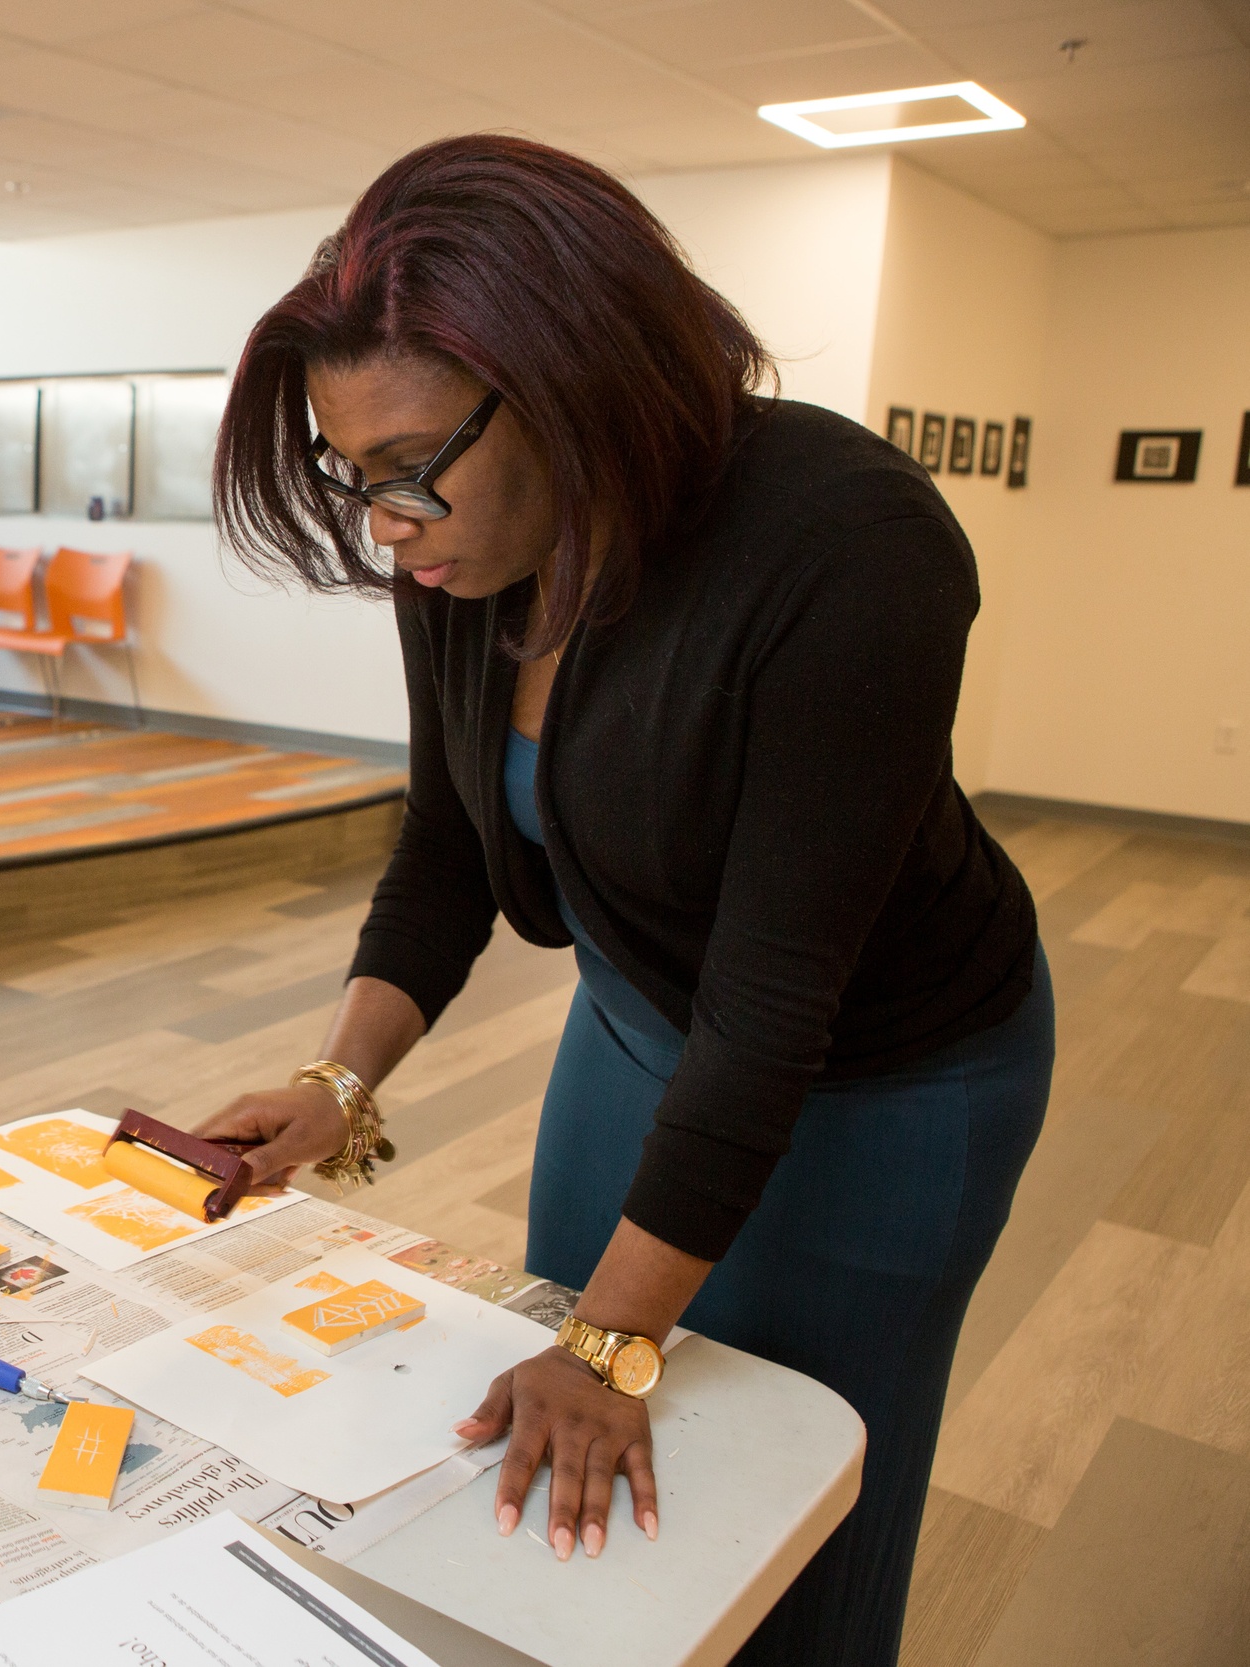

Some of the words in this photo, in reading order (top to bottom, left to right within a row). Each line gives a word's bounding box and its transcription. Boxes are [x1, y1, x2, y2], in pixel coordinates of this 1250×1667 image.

[221, 1455, 239, 1473] of
[126, 1463, 220, 1523] globaloney
[222, 1470, 267, 1494] The
[158, 1487, 225, 1530] politics
[72, 1550, 86, 1559] is
[10, 1556, 73, 1586] outrageous,
[118, 1637, 166, 1667] cho!
